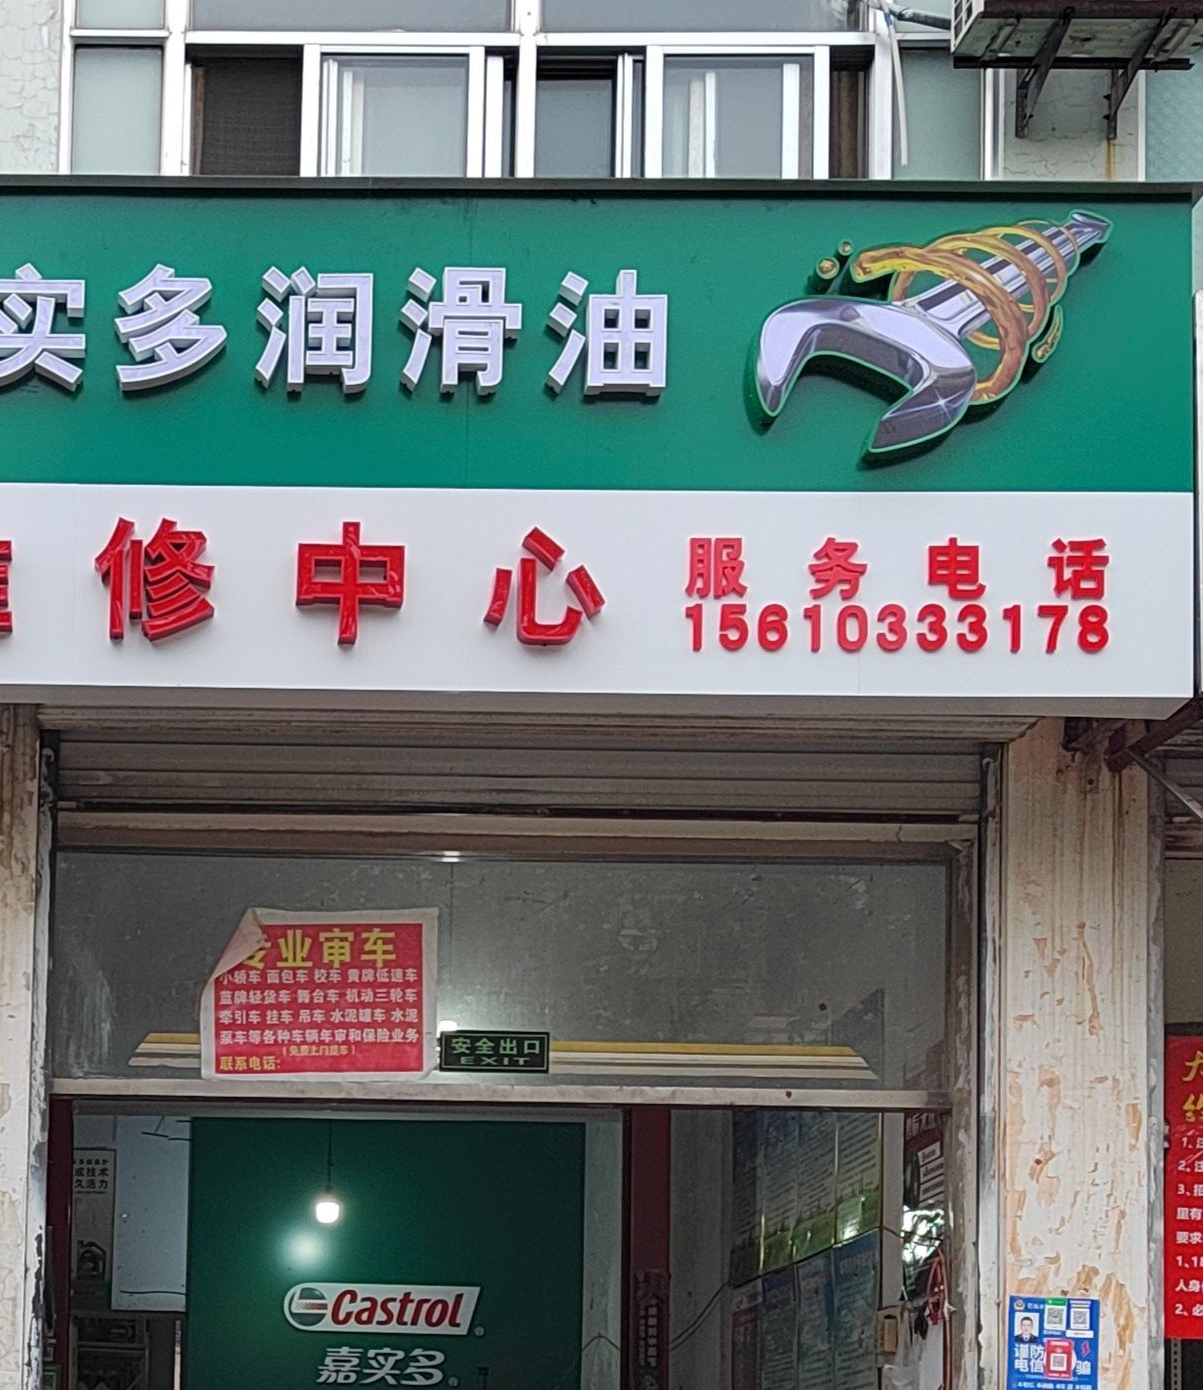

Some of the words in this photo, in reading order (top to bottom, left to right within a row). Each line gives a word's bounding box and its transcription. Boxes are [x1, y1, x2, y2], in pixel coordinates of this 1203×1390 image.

[685, 536, 1111, 600] 服务电话
[687, 603, 1111, 653] 15610333178
[266, 969, 309, 984] 面包车
[346, 988, 418, 1002] 机动三轮车
[299, 1009, 326, 1023] 吊车
[390, 1008, 418, 1022] 水泥
[451, 1037, 540, 1055] 安全出口
[460, 1056, 531, 1066] EXIT
[1176, 1207, 1203, 1221] 里有
[1176, 1231, 1203, 1245] 要求
[1174, 1278, 1203, 1293] 人身
[331, 1289, 464, 1328] Castrol
[316, 1346, 446, 1386] 嘉实多
